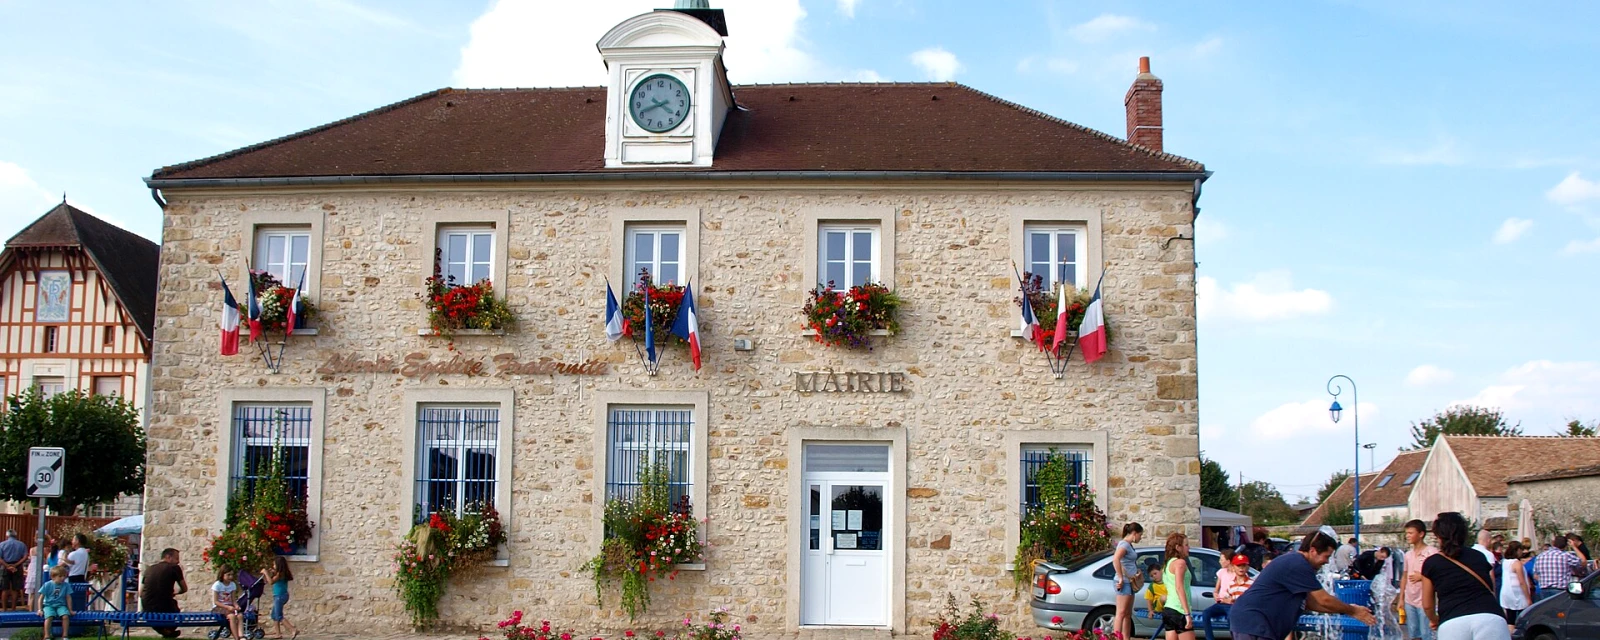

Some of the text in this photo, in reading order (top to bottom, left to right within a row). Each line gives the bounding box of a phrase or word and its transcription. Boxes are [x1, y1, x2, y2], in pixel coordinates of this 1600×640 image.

[493, 352, 609, 379] Fraternité
[794, 369, 905, 393] MAIRIE
[38, 473, 51, 482] 30
